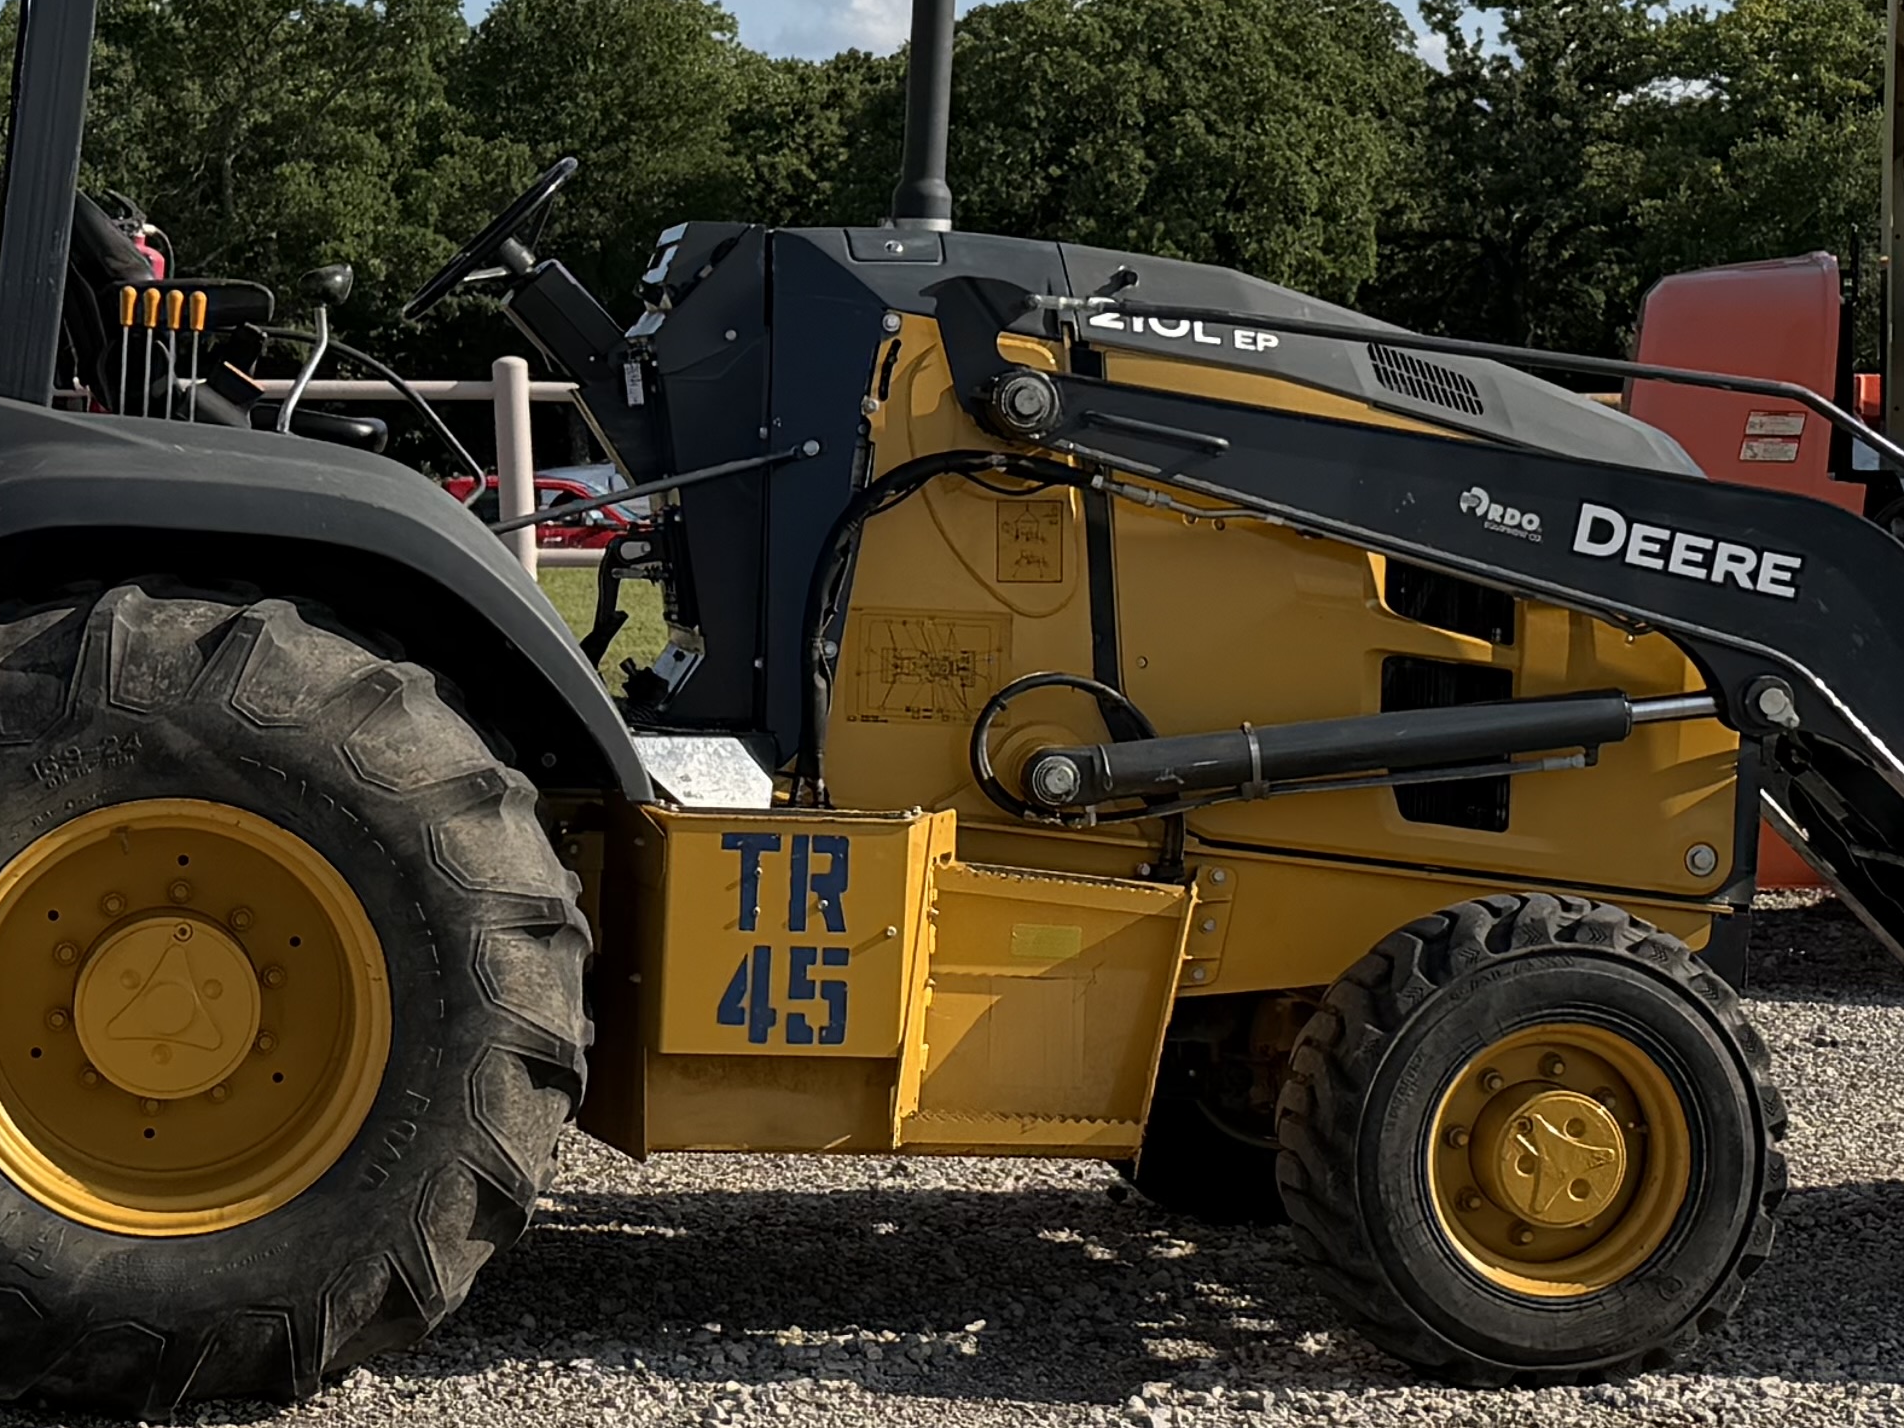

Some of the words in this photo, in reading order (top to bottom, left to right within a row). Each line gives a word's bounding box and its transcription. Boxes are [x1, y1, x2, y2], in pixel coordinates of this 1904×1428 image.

[1234, 329, 1280, 351] EP
[1487, 503, 1540, 531] RDO
[1572, 502, 1802, 598] DEERE
[720, 832, 850, 933] TR
[716, 945, 850, 1046] 45
